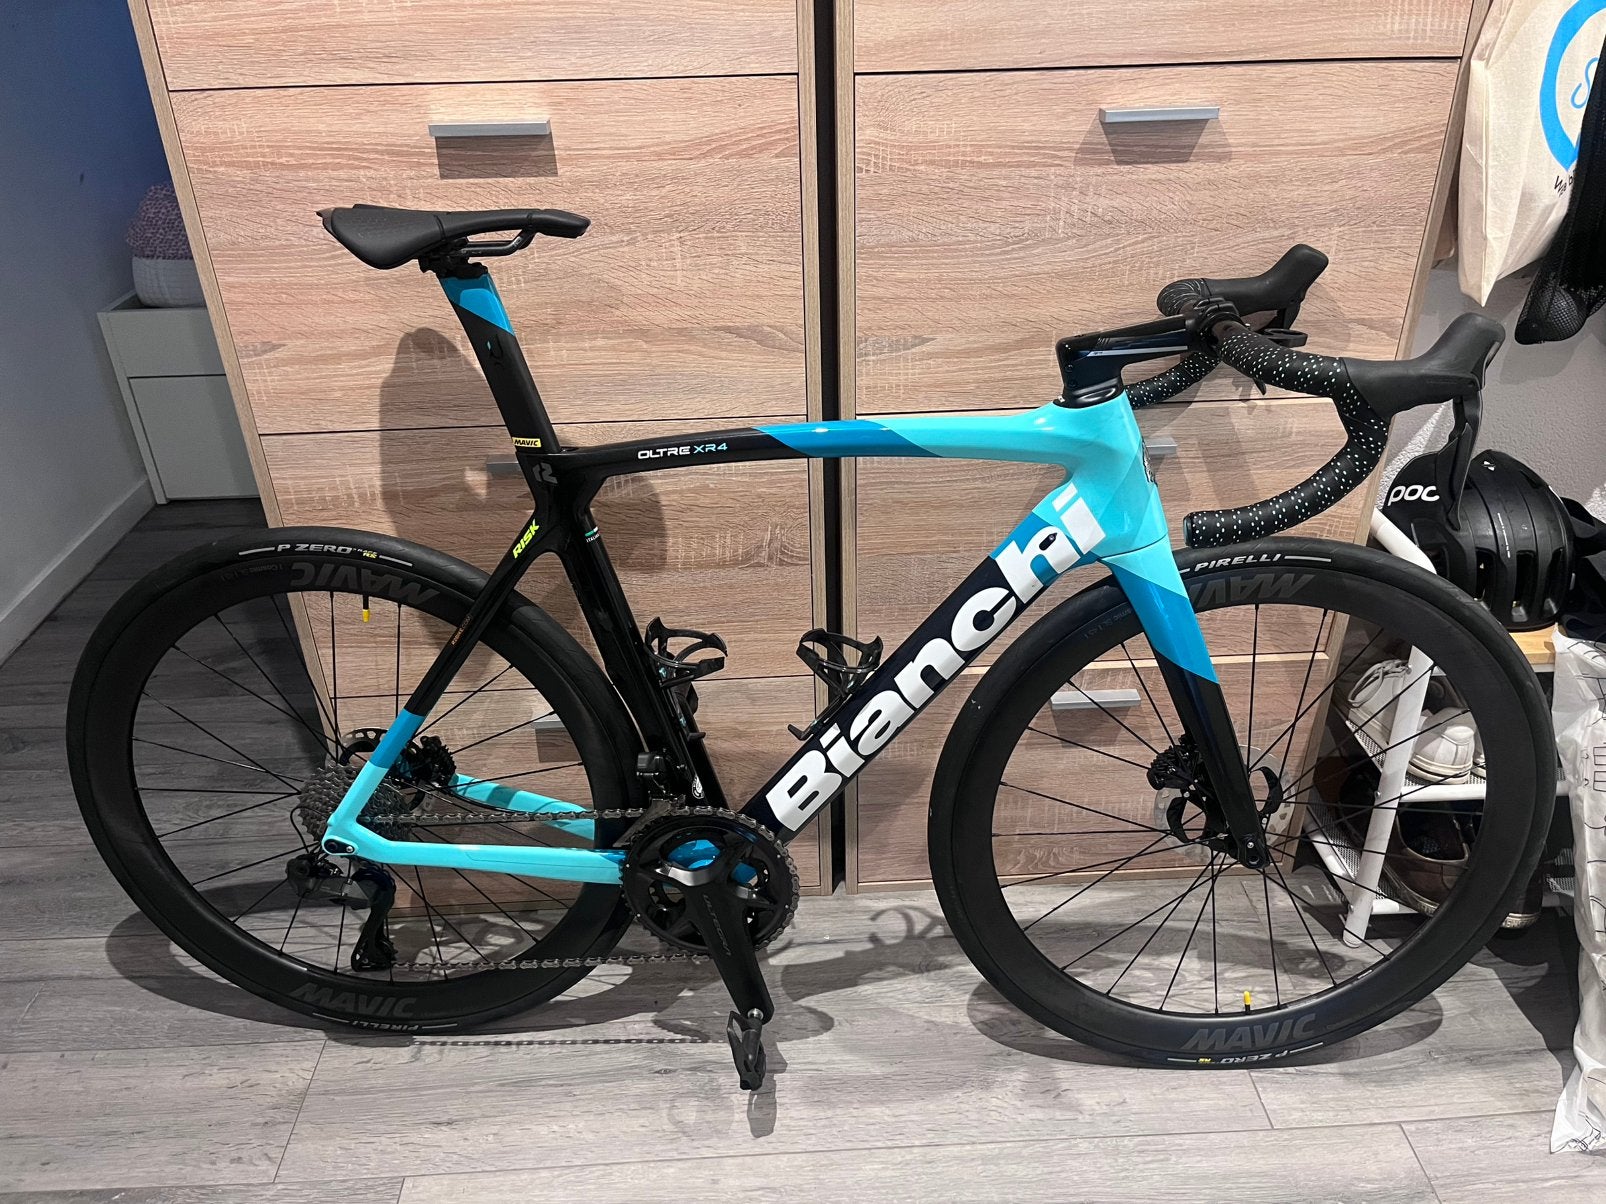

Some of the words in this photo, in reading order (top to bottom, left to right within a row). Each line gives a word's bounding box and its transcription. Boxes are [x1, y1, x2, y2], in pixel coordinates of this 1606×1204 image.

[514, 438, 539, 448] MAVIC
[637, 445, 691, 460] OLTRE
[693, 442, 728, 455] XR4
[277, 543, 291, 552] P
[295, 543, 353, 554] ZERO
[512, 518, 540, 560] RISK
[1194, 553, 1282, 572] PIRELLI
[290, 561, 441, 605] MAVIC
[765, 482, 1106, 832] Bianchi
[287, 982, 417, 1018] MAVIC
[352, 1020, 419, 1032] PIRELLI
[1180, 1013, 1316, 1050] MAVIC
[1220, 1052, 1273, 1064] ZERO
